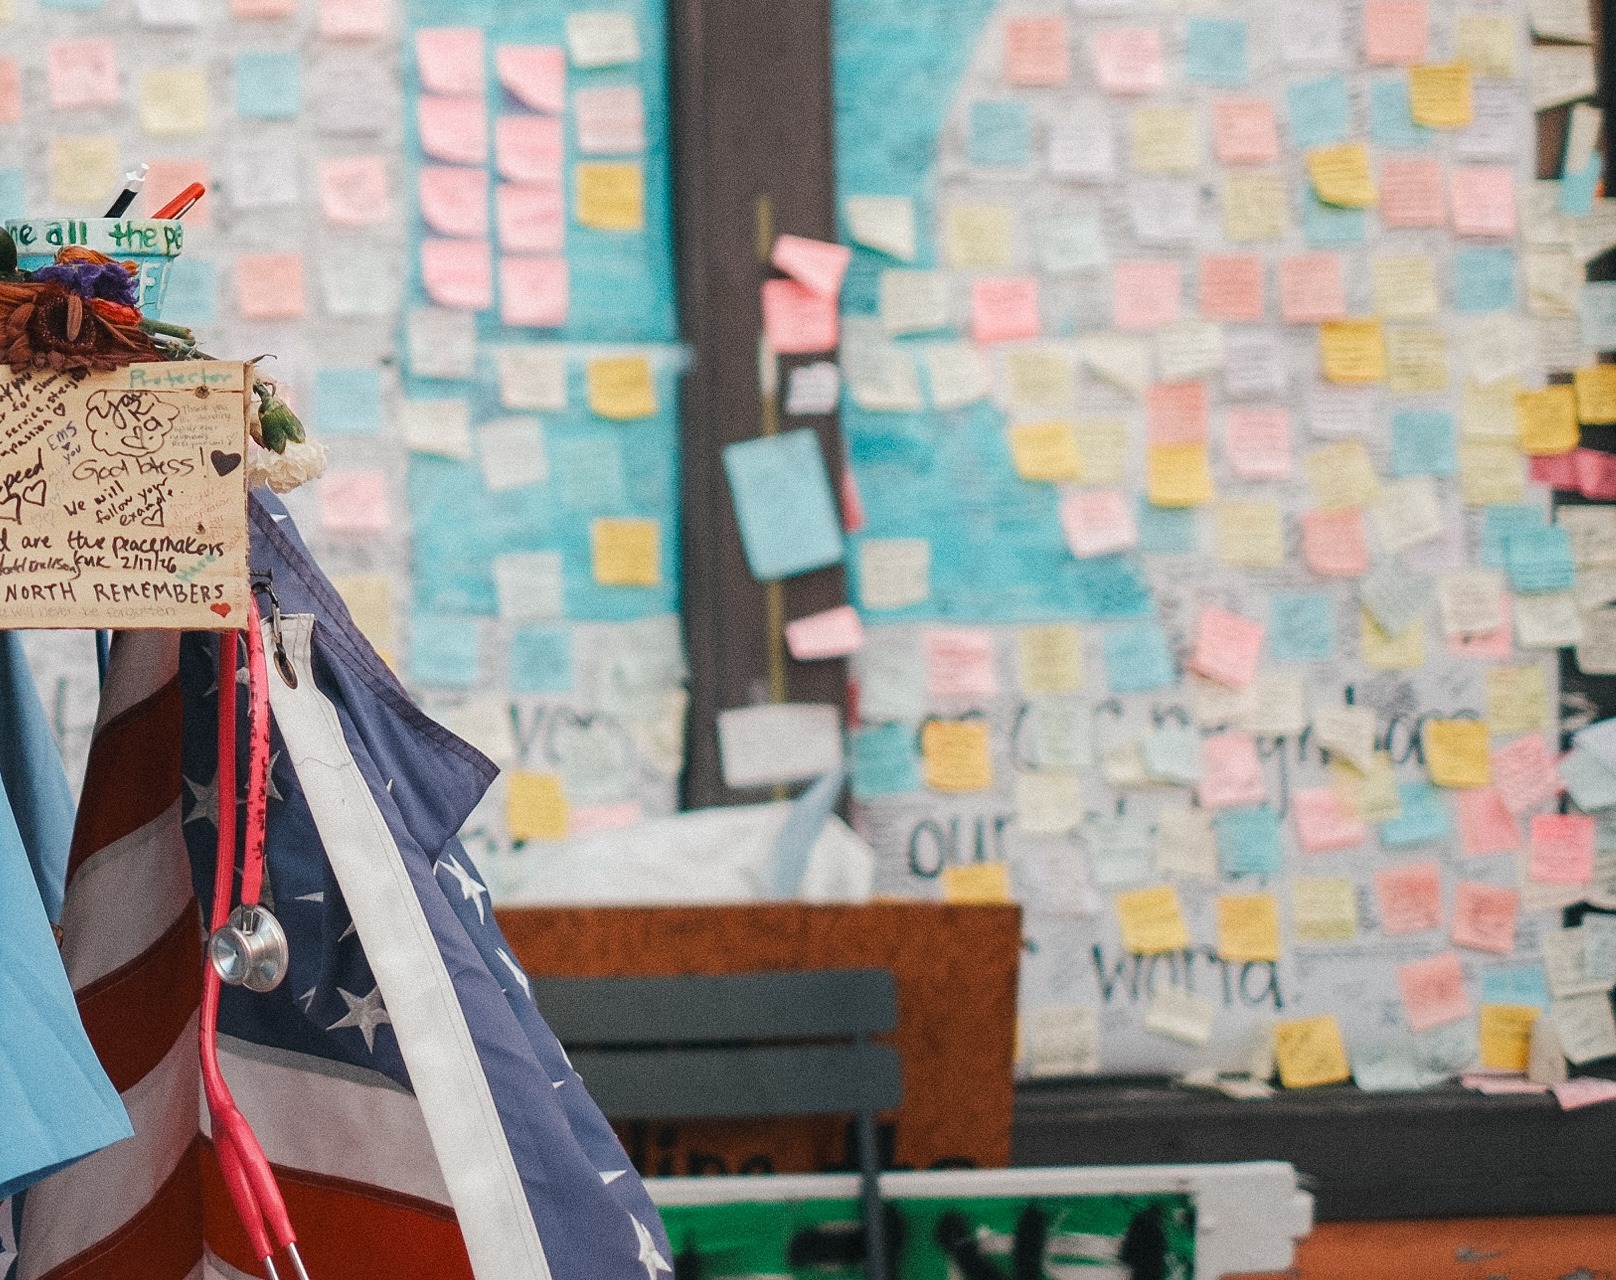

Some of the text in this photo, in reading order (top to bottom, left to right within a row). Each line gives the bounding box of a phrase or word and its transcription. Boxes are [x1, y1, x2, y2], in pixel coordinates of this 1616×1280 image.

[45, 220, 87, 246] all
[108, 220, 158, 248] the
[46, 420, 77, 451] EMS
[73, 458, 130, 484] God
[95, 480, 124, 504] will
[96, 495, 133, 524] follow
[21, 534, 52, 549] are
[112, 535, 225, 559] peacemakers
[5, 581, 77, 602] NORTH
[93, 580, 225, 604] REMEMBERS
